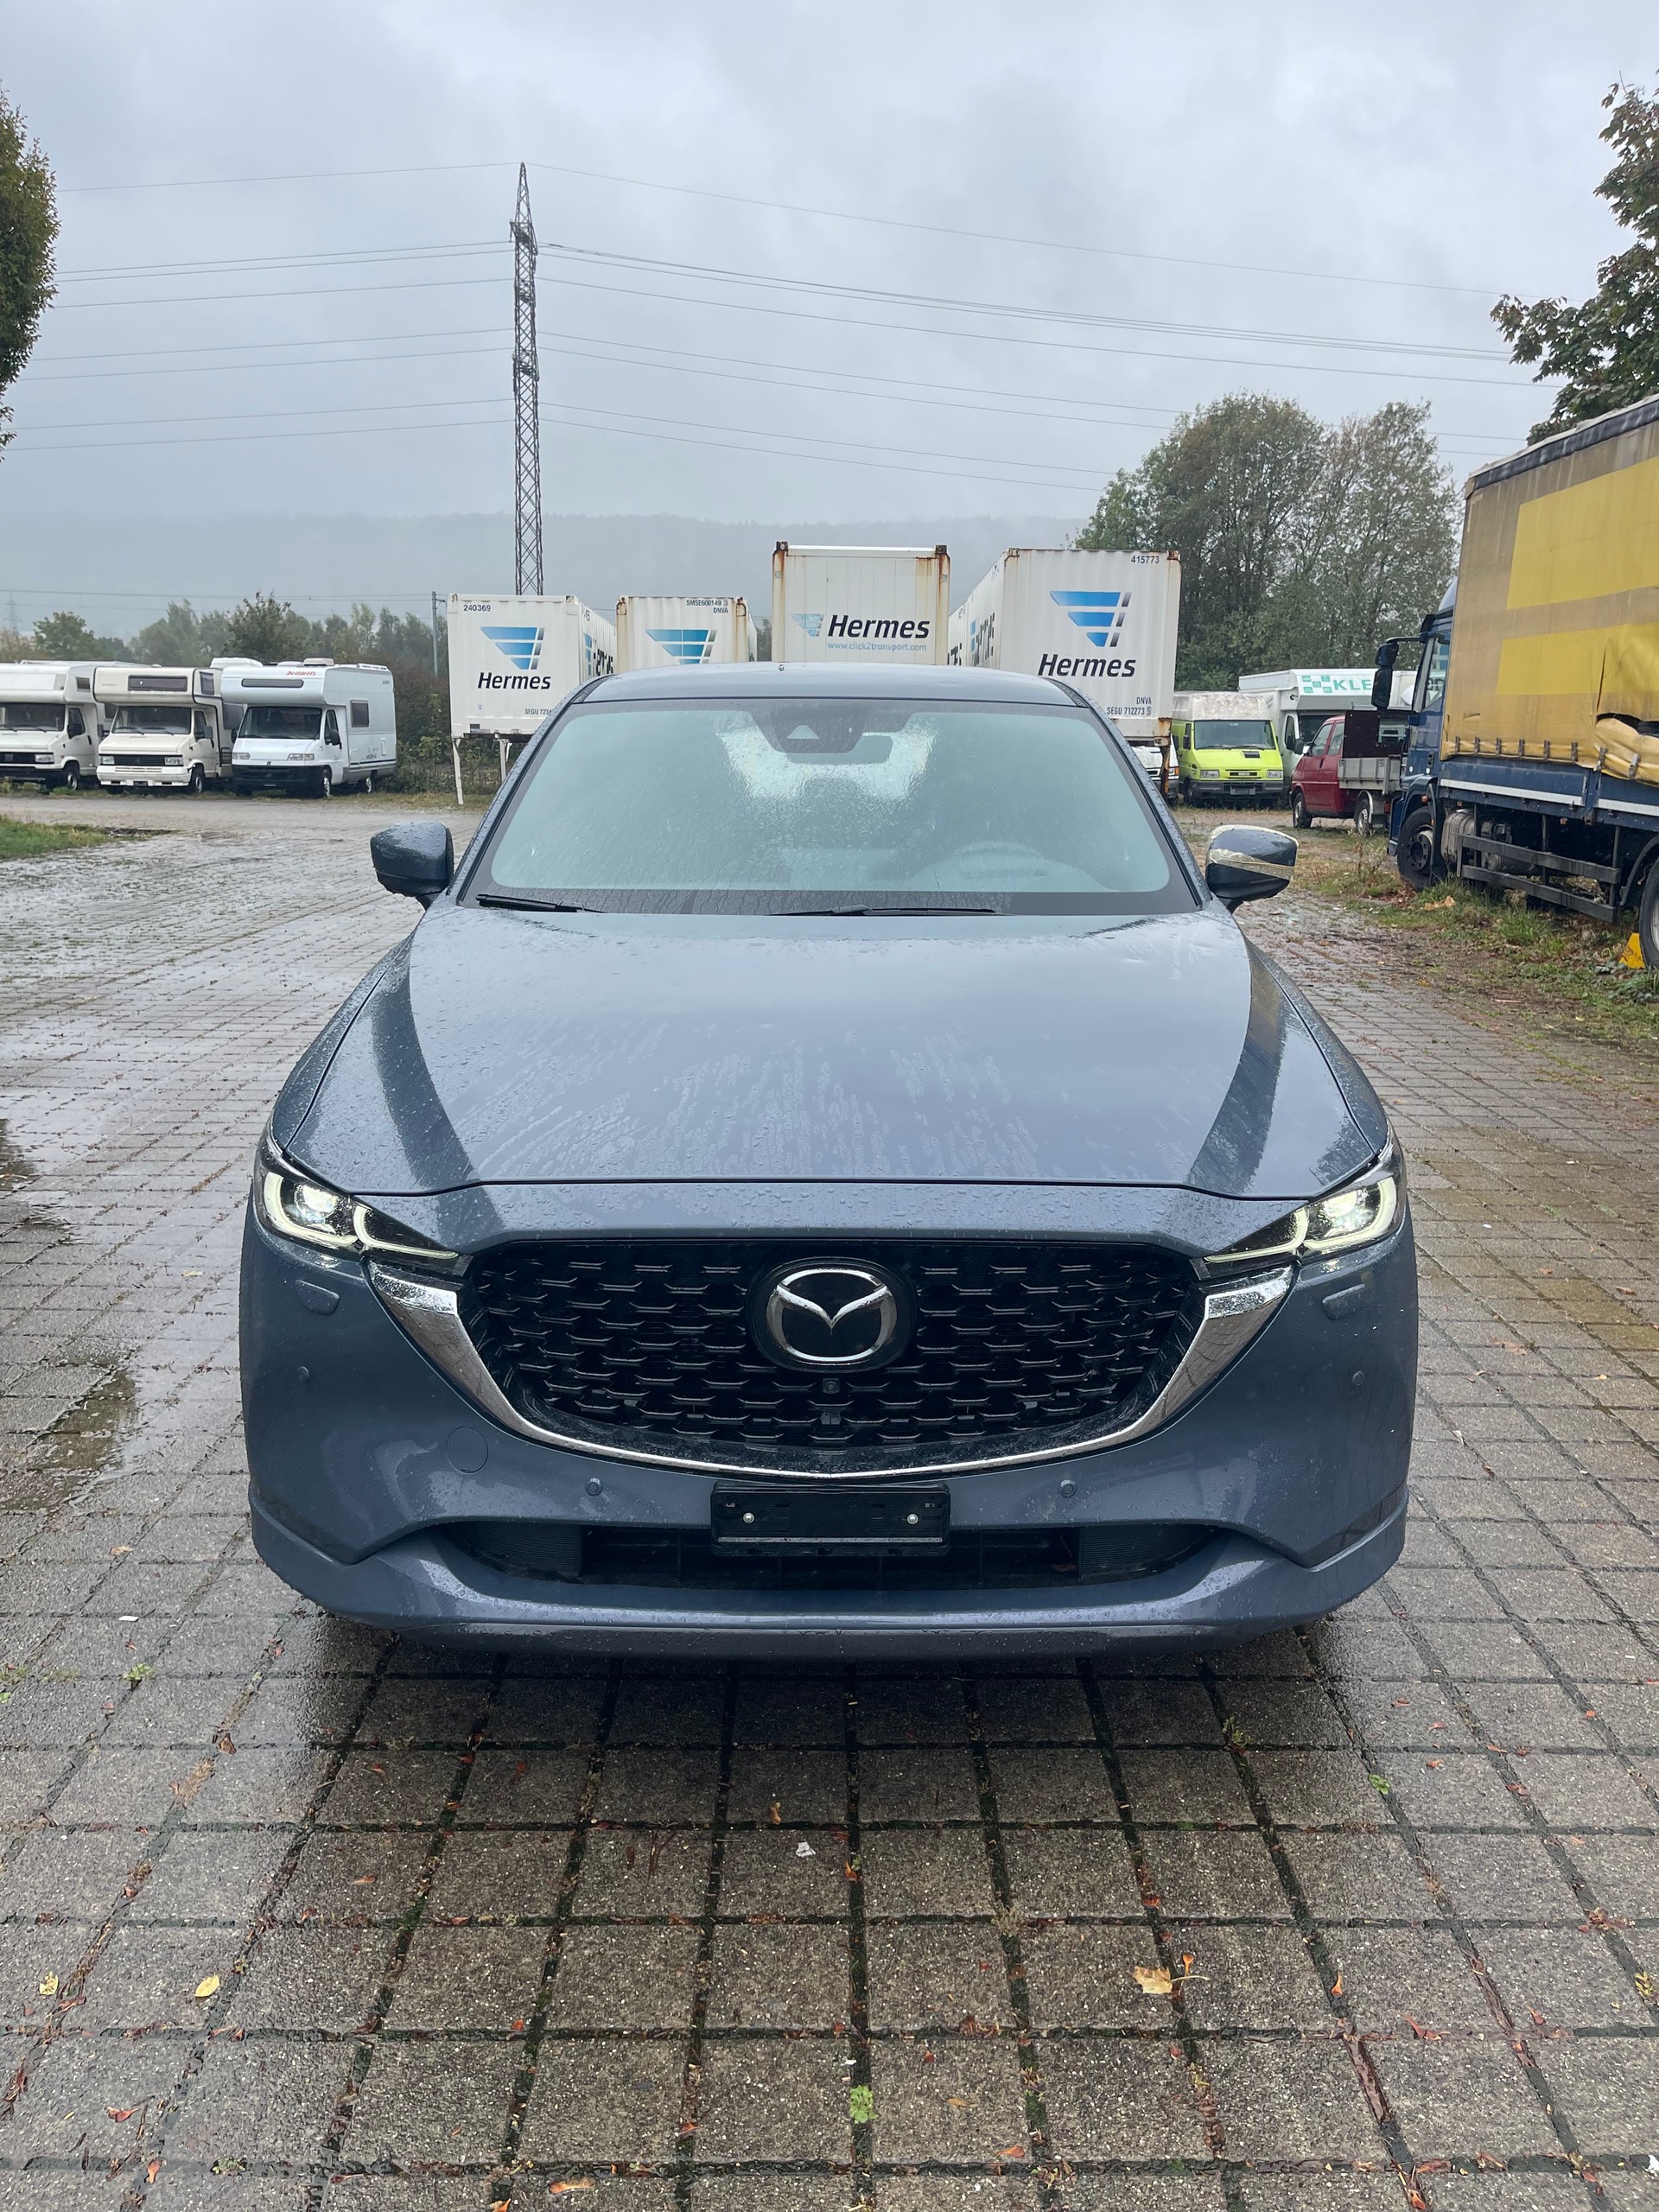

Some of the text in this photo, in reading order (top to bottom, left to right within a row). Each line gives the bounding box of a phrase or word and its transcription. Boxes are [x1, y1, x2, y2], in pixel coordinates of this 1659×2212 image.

[828, 614, 931, 639] Hermes
[827, 642, 927, 652] www.click2transport.com
[1037, 653, 1136, 677] Hermes
[477, 671, 551, 690] Hermes
[1124, 707, 1145, 715] 712273
